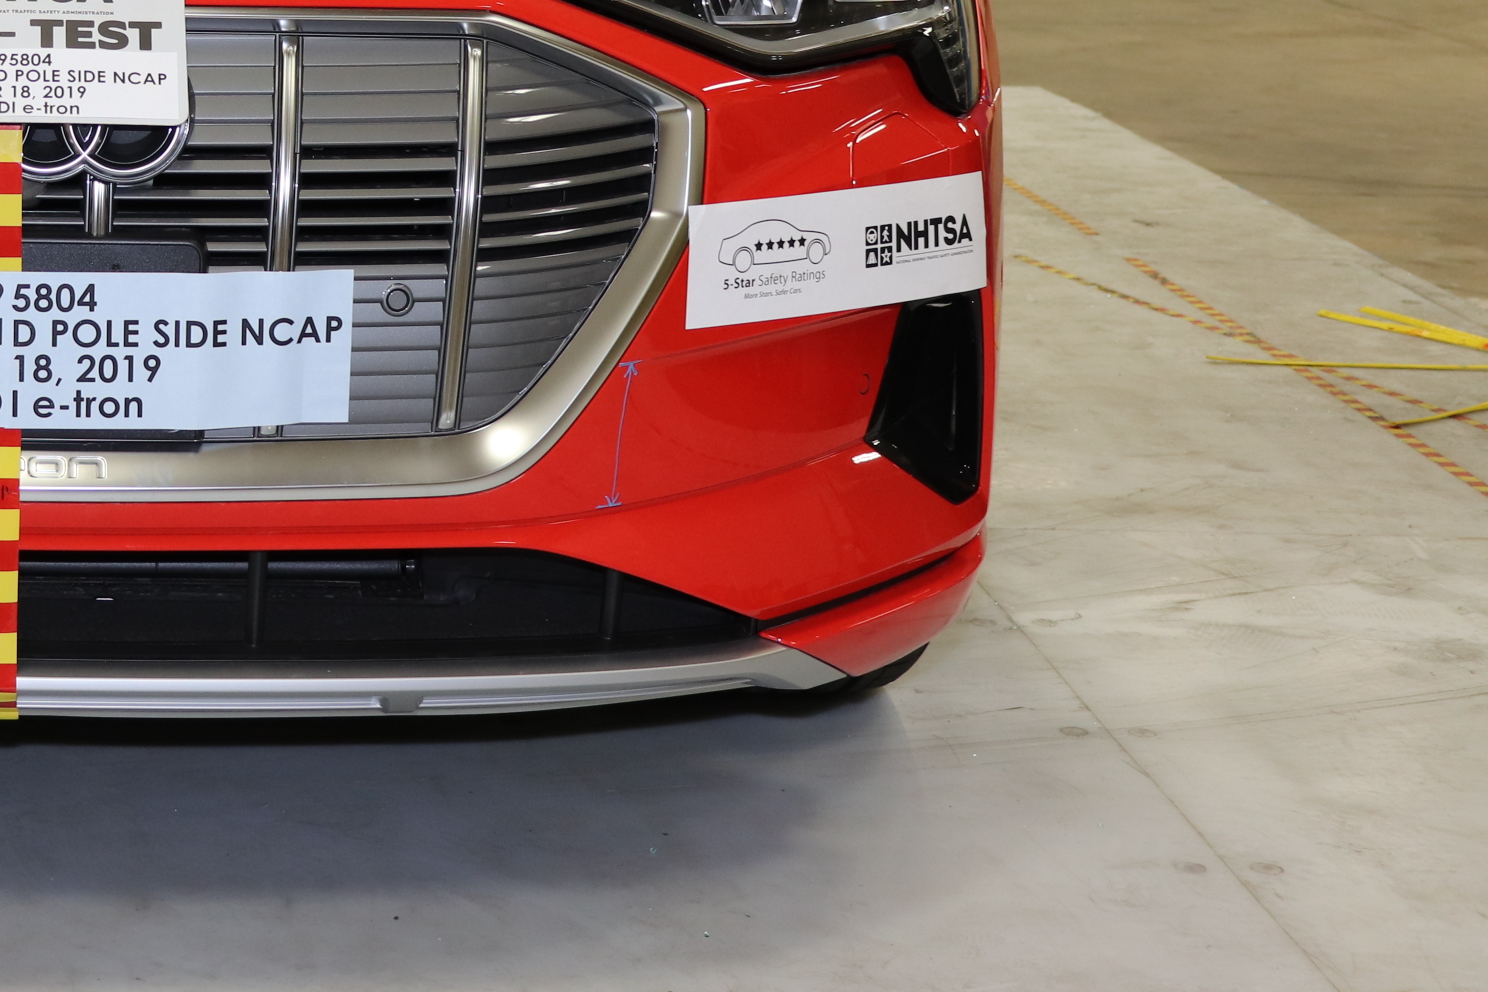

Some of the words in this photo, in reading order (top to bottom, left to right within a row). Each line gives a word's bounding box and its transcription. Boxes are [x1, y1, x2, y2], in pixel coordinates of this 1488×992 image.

[29, 18, 163, 51] TEST
[15, 69, 60, 83] POLE
[67, 69, 106, 83] SIDE
[113, 71, 167, 86] NCAP
[11, 85, 37, 101] 18,
[43, 85, 87, 99] 2019
[22, 101, 80, 115] e-tron
[896, 213, 973, 253] NHTSA
[723, 277, 756, 290] 5-Star
[758, 272, 788, 287] Safety
[791, 269, 826, 283] Ratings
[51, 318, 140, 349] POLE
[152, 319, 228, 349] SIDE
[241, 315, 343, 347] NCAP
[14, 354, 63, 387] 18,
[75, 354, 162, 384] 2019
[32, 389, 143, 419] e-tron
